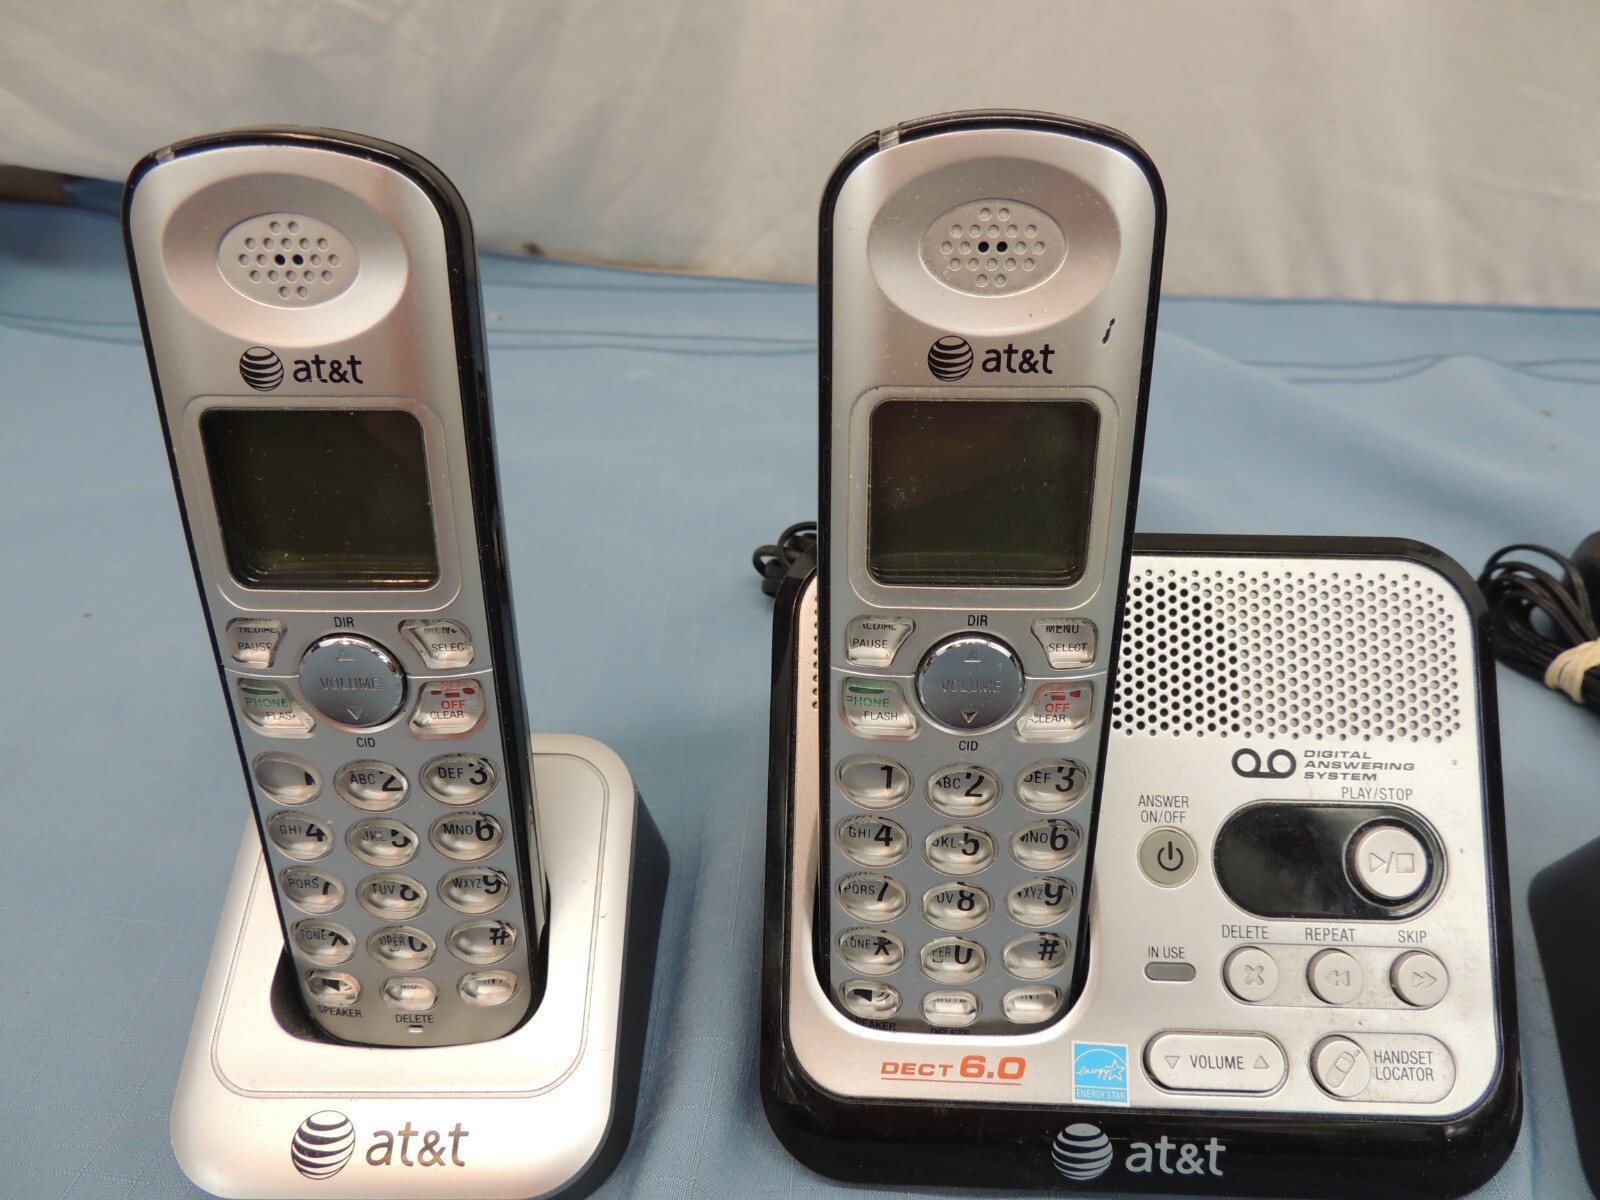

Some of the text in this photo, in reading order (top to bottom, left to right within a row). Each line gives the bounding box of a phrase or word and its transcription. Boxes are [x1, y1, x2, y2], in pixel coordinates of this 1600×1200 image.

[982, 343, 1055, 374] at&t
[293, 354, 363, 384] at&t
[334, 616, 354, 628] DIR
[967, 615, 988, 627] DIR
[431, 642, 465, 652] SELEC
[852, 638, 888, 649] PAUSE
[1048, 643, 1088, 652] SELECT
[320, 677, 380, 691] VOLUME
[940, 679, 1002, 693] VOLUME
[441, 700, 466, 709] OFF
[1044, 702, 1071, 713] OFF
[429, 710, 465, 719] CLEAR
[864, 711, 898, 721] FLASH
[356, 737, 376, 748] CID
[958, 740, 979, 751] CID
[1303, 749, 1372, 760] DIGITAL
[437, 766, 464, 779] DEF
[1303, 761, 1415, 771] ANSWERING
[350, 772, 376, 785] ABC
[880, 765, 895, 790] 1
[1303, 771, 1377, 782] SYSTEM
[1341, 786, 1413, 801] PLAY/STOP
[1138, 795, 1189, 808] ANSWER
[1141, 810, 1186, 824] ON/OFF
[279, 824, 303, 835] GHI
[443, 819, 495, 842] MNO 6
[848, 823, 893, 847] GHI 4
[1050, 826, 1069, 851] 6
[452, 877, 482, 889] WXYZ
[300, 929, 327, 941] TONE
[1222, 925, 1269, 939] DELETE
[1304, 927, 1356, 942] REPEAT
[1397, 930, 1427, 943] SKIP
[1148, 947, 1185, 959] IN USE
[317, 1004, 362, 1018] SPEAKER
[395, 1014, 434, 1024] DELETE
[1190, 1055, 1245, 1070] VOLUME
[1374, 1050, 1433, 1065] HANDSET
[880, 1055, 1027, 1080] DECT 6.0
[1375, 1066, 1434, 1081] LOCATOR
[1076, 1088, 1127, 1101] ENERGY STAR
[366, 1121, 469, 1167] at&t
[1125, 1135, 1226, 1176] at&t
